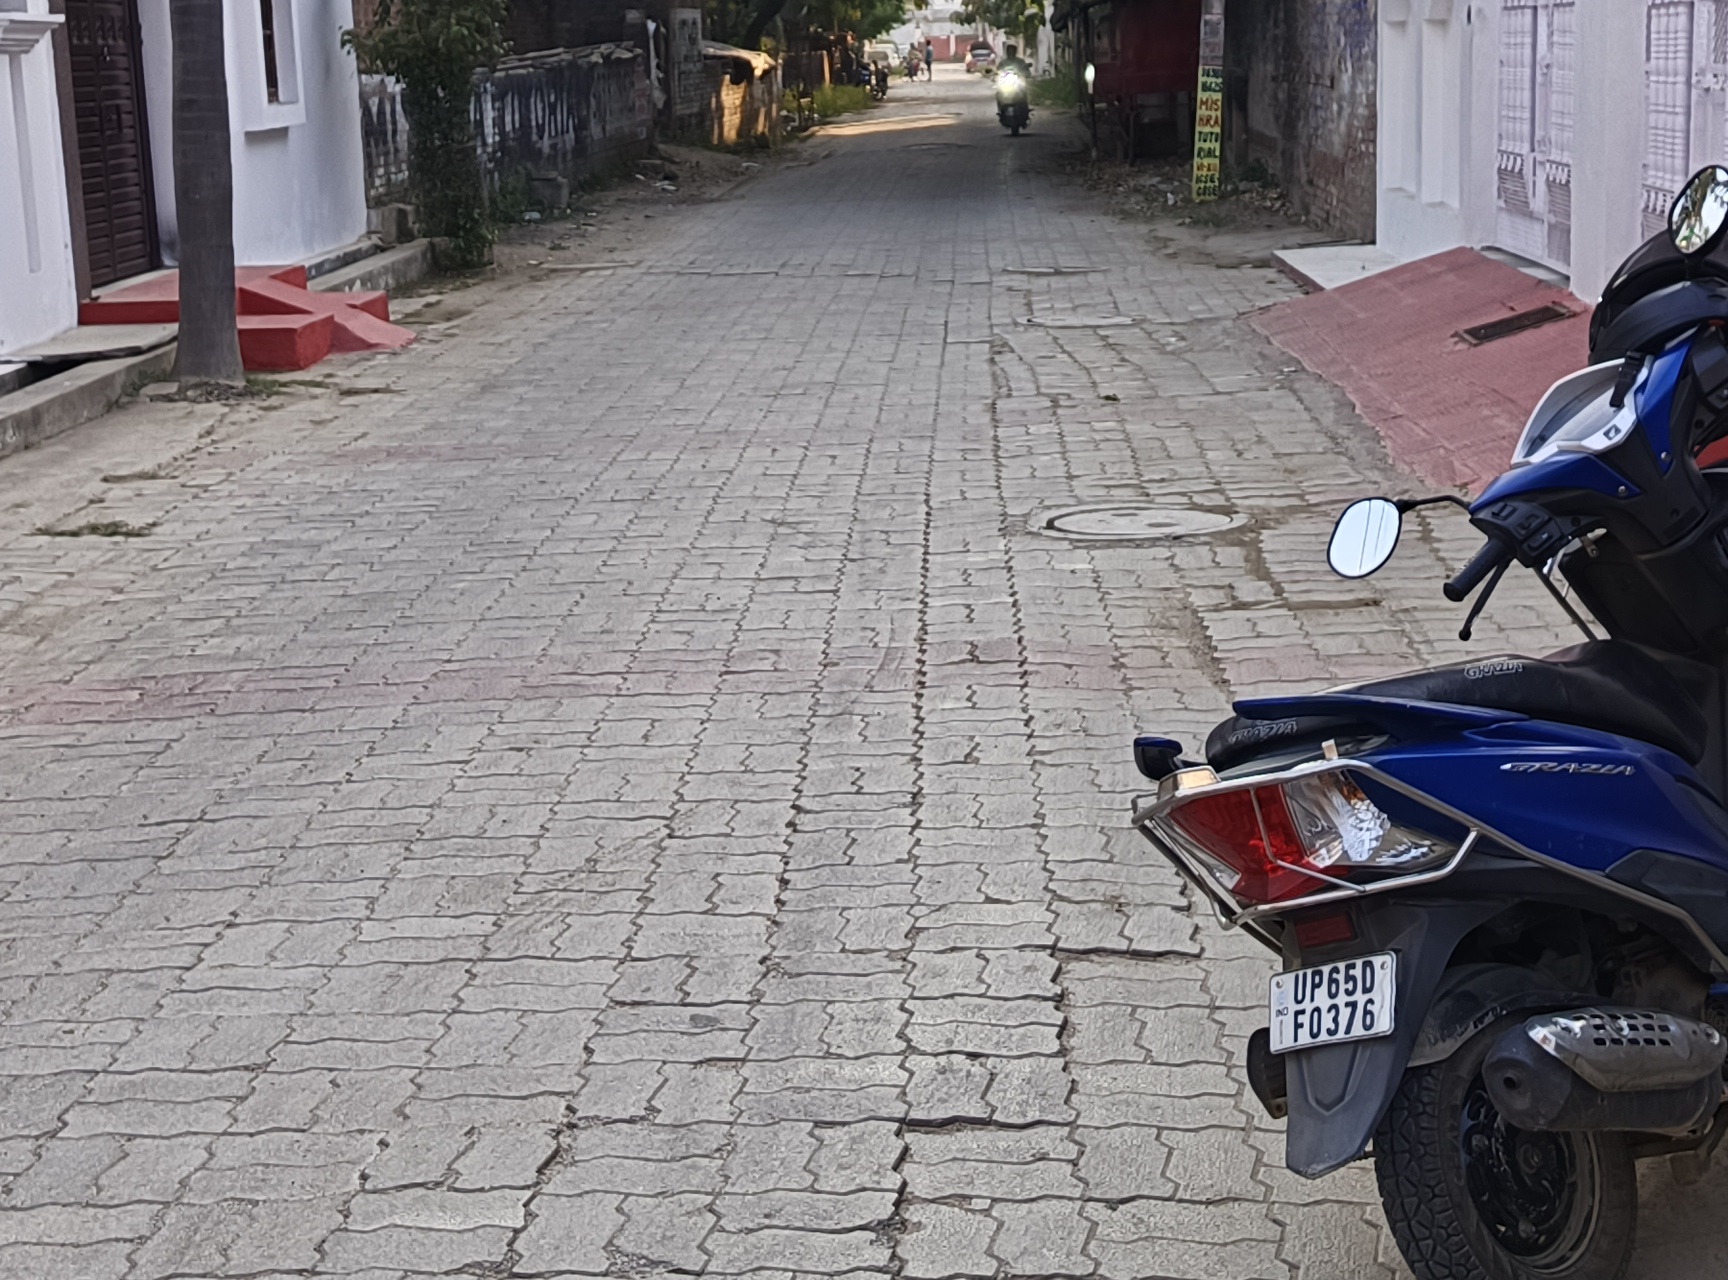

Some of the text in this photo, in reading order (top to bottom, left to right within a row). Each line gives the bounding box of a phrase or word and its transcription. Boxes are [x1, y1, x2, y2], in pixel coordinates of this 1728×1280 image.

[1199, 95, 1220, 111] MIS
[1500, 761, 1636, 776] GRAZIA
[1293, 959, 1376, 1005] UP65D
[1293, 997, 1375, 1044] F0376
